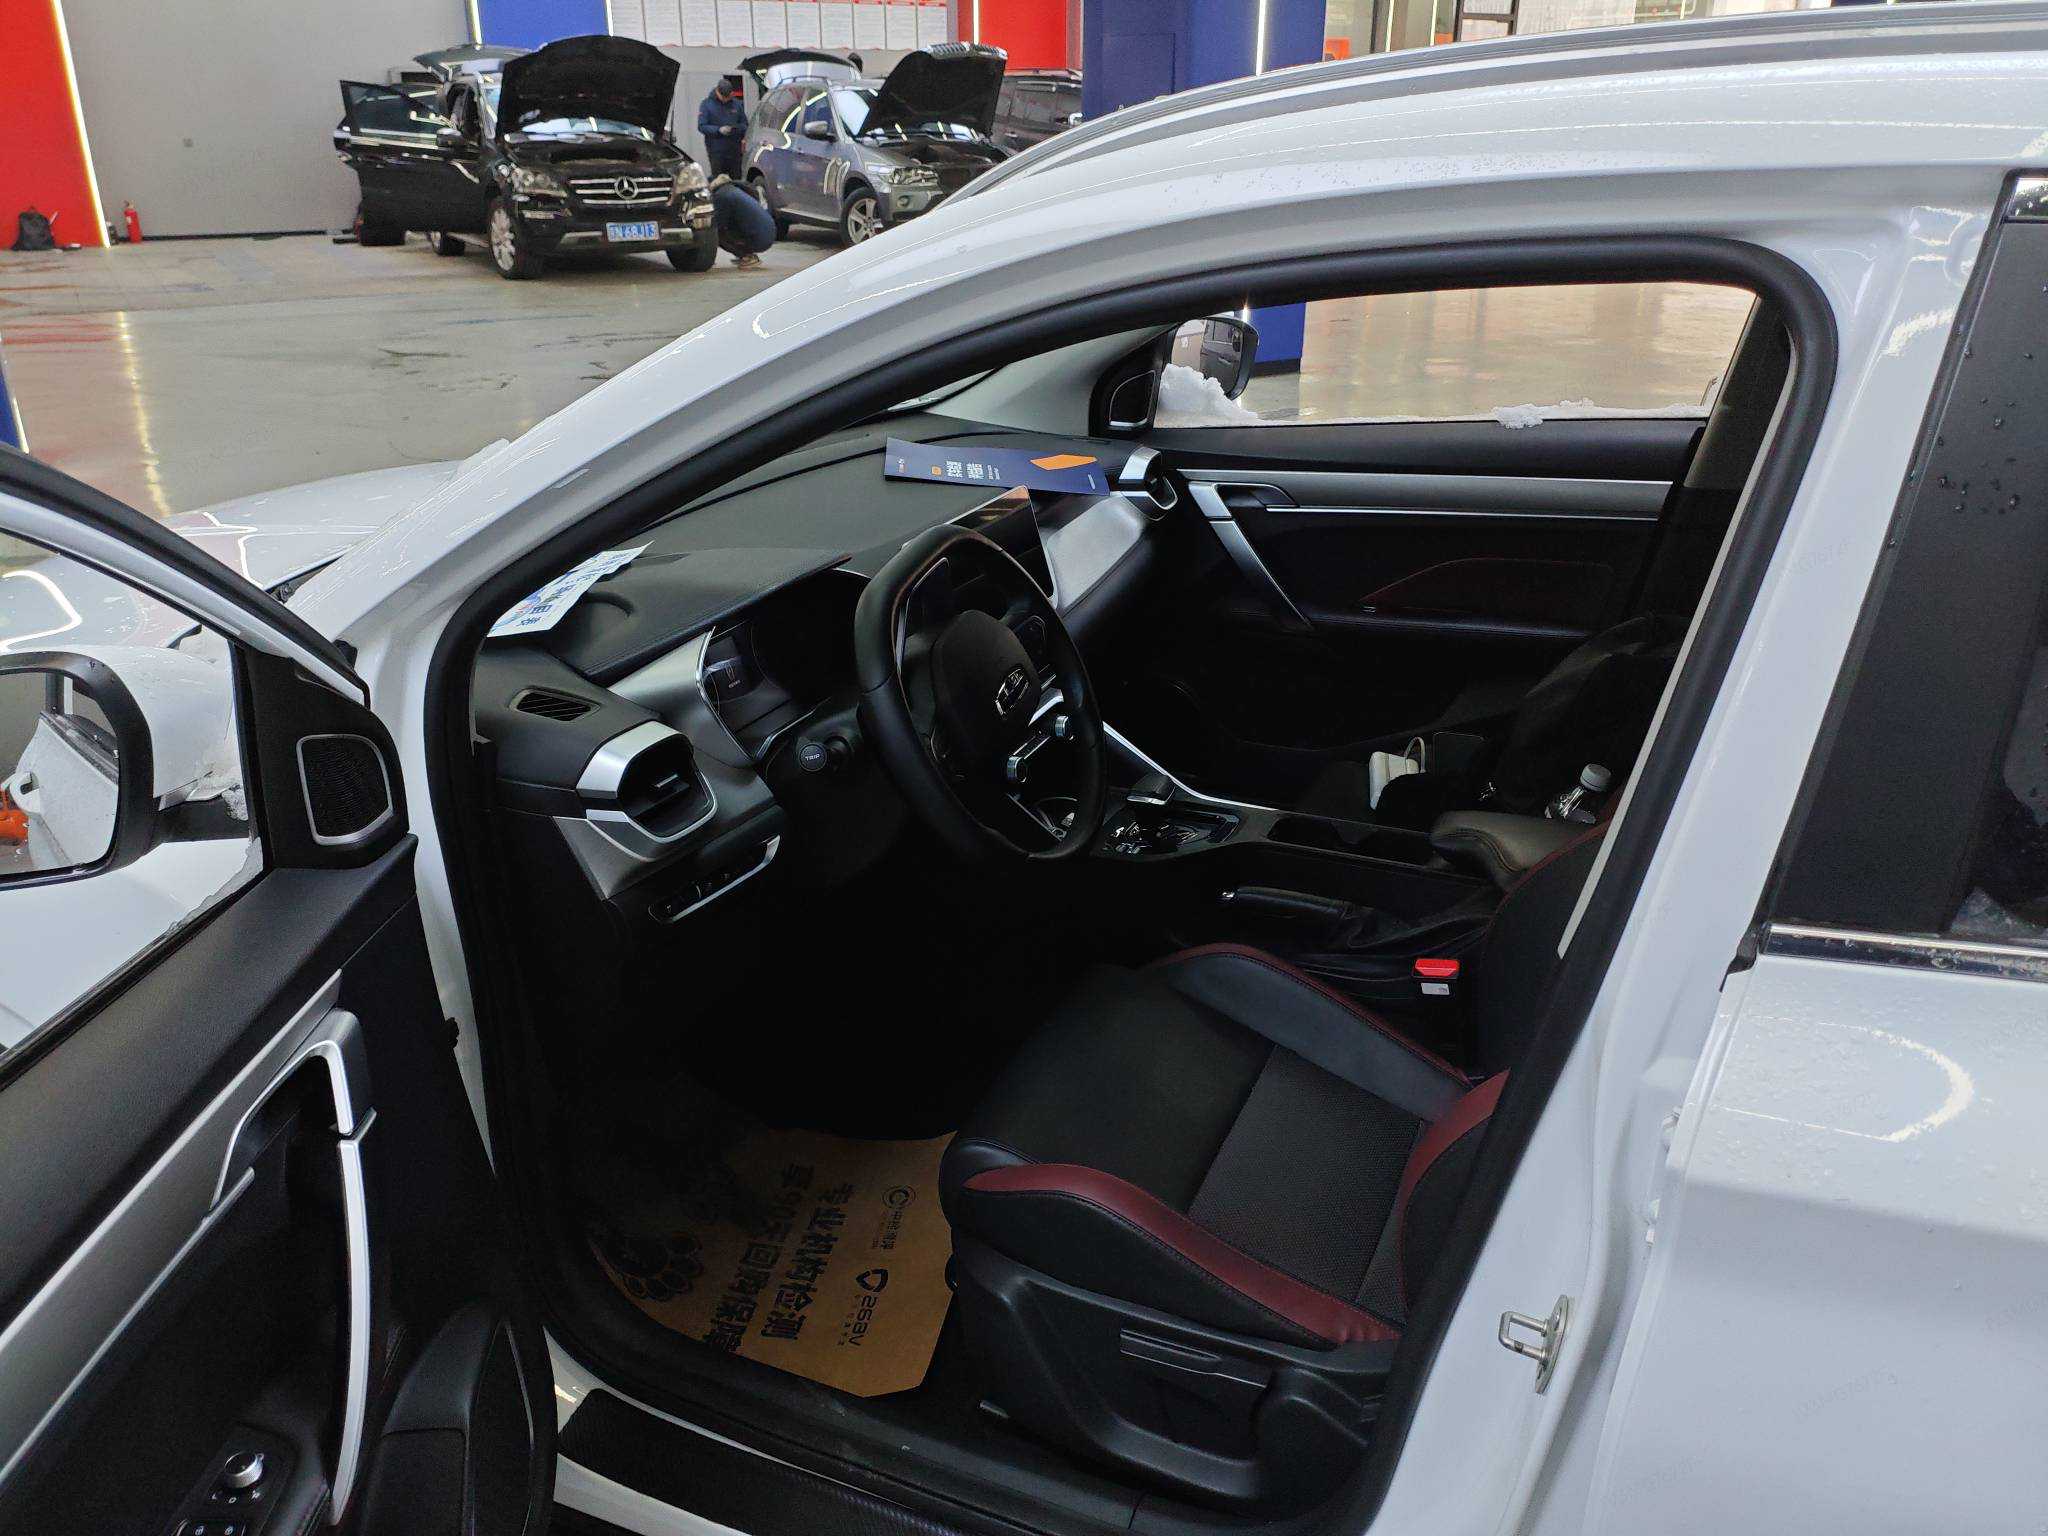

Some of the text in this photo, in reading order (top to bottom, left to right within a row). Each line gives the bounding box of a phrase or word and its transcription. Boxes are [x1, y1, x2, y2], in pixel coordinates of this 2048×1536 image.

[760, 1182, 855, 1341] 专业机构检测
